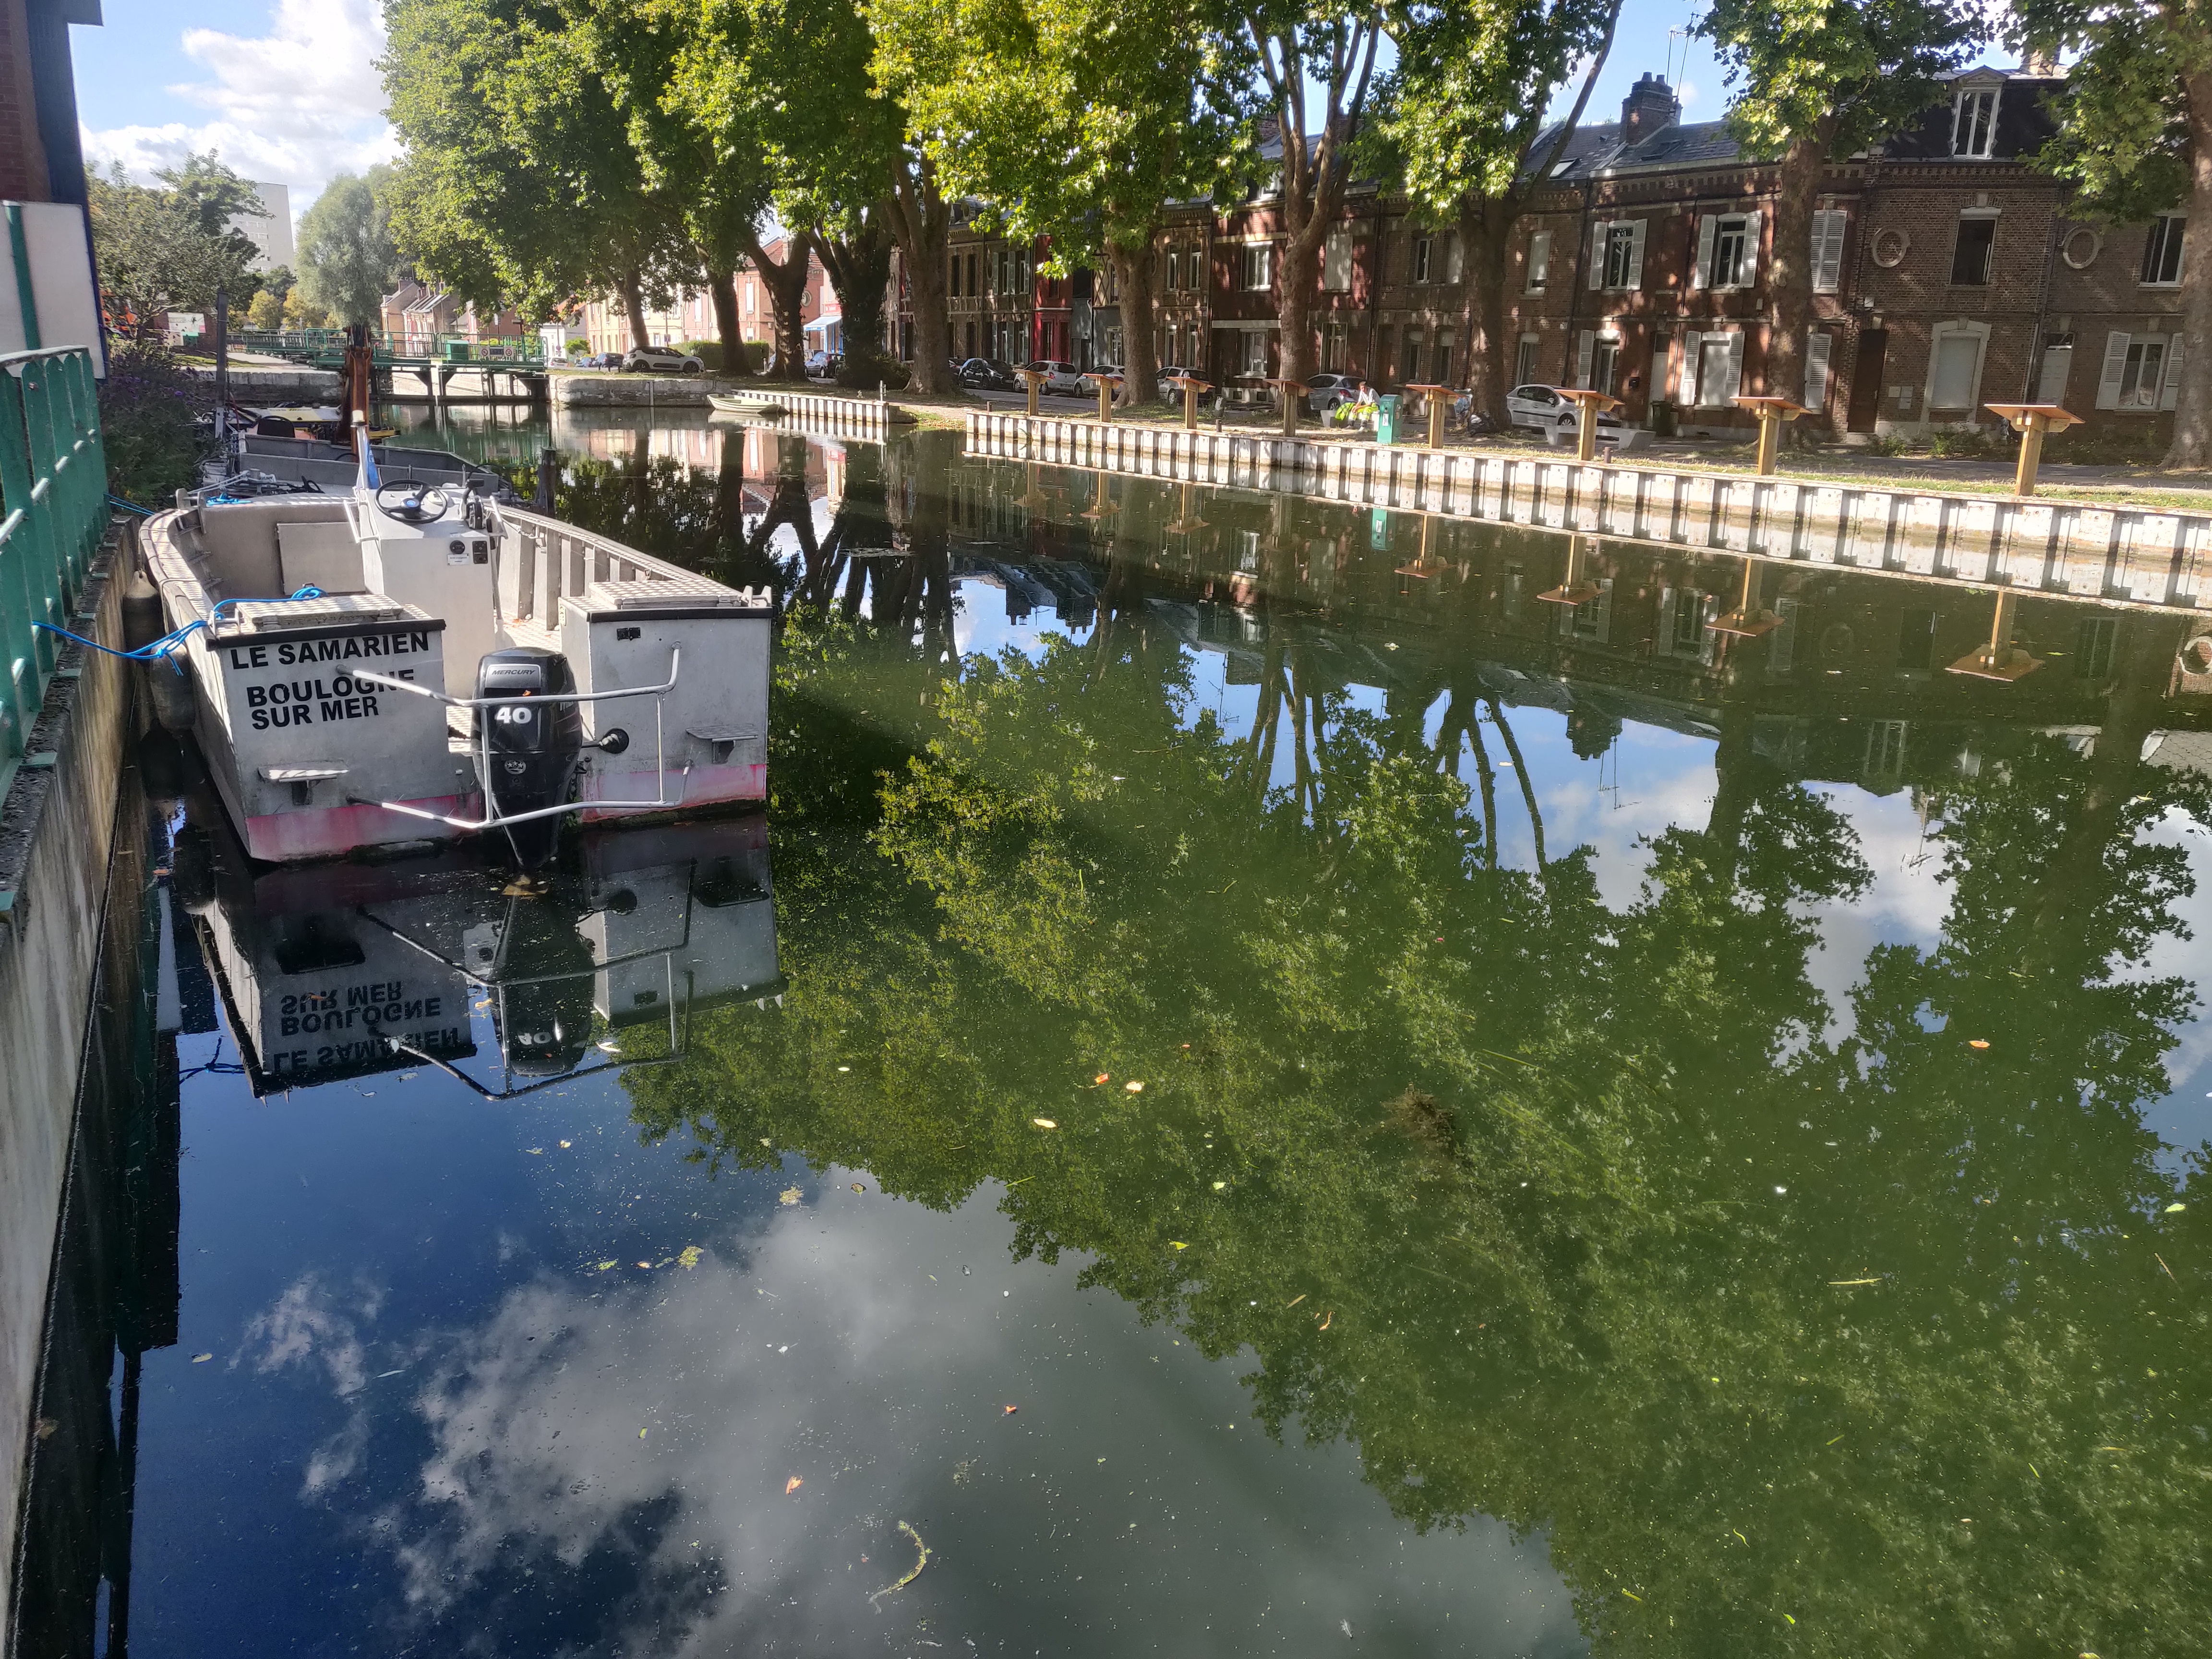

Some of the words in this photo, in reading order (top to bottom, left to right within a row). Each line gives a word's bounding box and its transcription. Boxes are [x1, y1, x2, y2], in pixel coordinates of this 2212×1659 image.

[231, 646, 269, 670] LE
[278, 631, 430, 665] SAMARIEN
[247, 669, 414, 707] BOULOGNE
[252, 704, 312, 730] SUR
[321, 696, 379, 721] MER
[496, 707, 531, 724] 40
